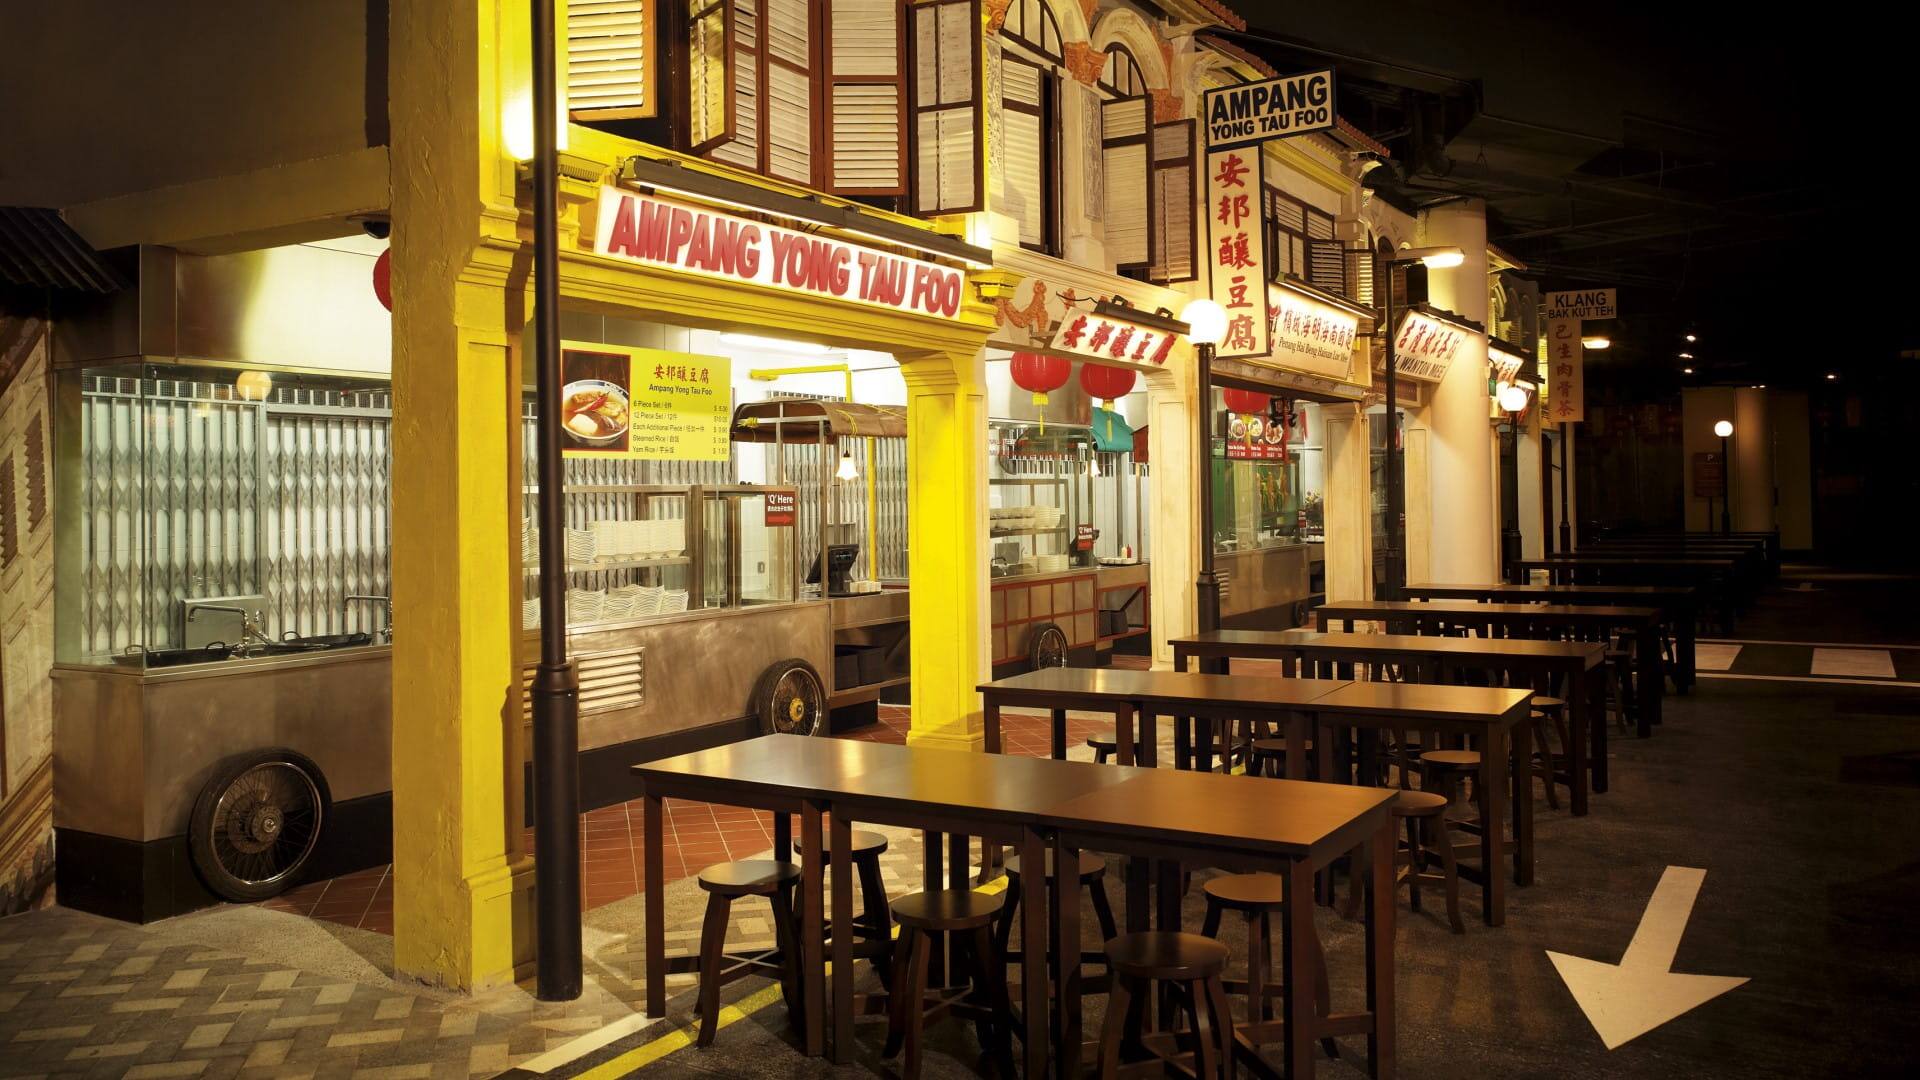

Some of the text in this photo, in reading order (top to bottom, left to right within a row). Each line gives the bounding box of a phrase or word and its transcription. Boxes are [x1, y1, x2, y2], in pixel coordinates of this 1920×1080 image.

[1210, 76, 1328, 125] AMPANG
[1211, 107, 1328, 141] YONG TAU FOO
[608, 195, 961, 317] AMPANG YONG TAU FOO
[1214, 153, 1258, 351] 安邦釀豆腐
[1555, 292, 1607, 307] KLANG
[1549, 306, 1614, 319] BAK KUT TEH
[1279, 337, 1296, 353] Penang
[1296, 341, 1305, 352] Hai
[1400, 356, 1431, 376] WANTON
[649, 383, 712, 396] Ampang Yong Tau Foo
[638, 400, 652, 408] Piece
[633, 434, 654, 442] Steamed
[778, 494, 793, 504] Here
